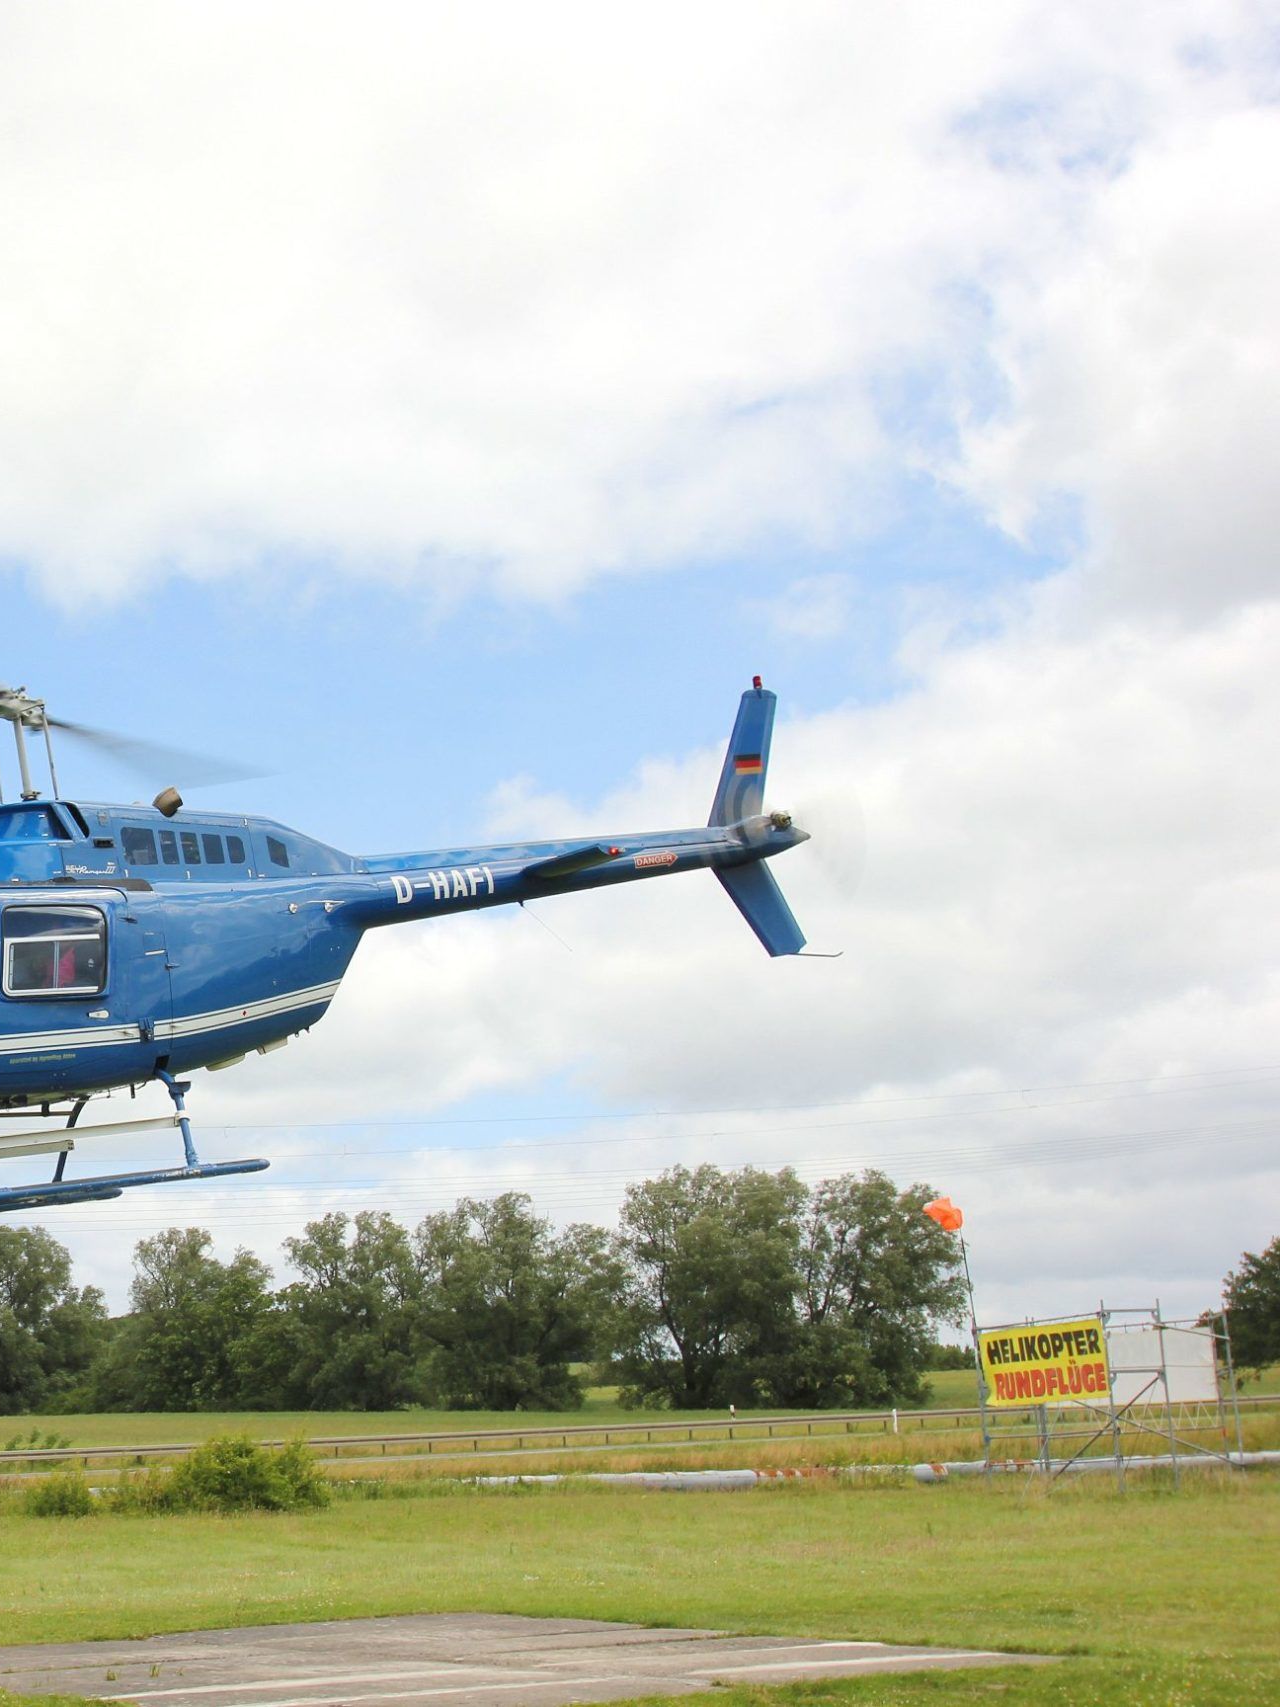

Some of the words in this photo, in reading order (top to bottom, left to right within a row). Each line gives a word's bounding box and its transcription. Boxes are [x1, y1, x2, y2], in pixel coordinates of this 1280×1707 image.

[636, 854, 673, 866] DANGER
[390, 866, 494, 904] D-HAFI
[987, 1328, 1101, 1365] HELIKOPTER
[994, 1359, 1107, 1401] RUNDFLÜGE
